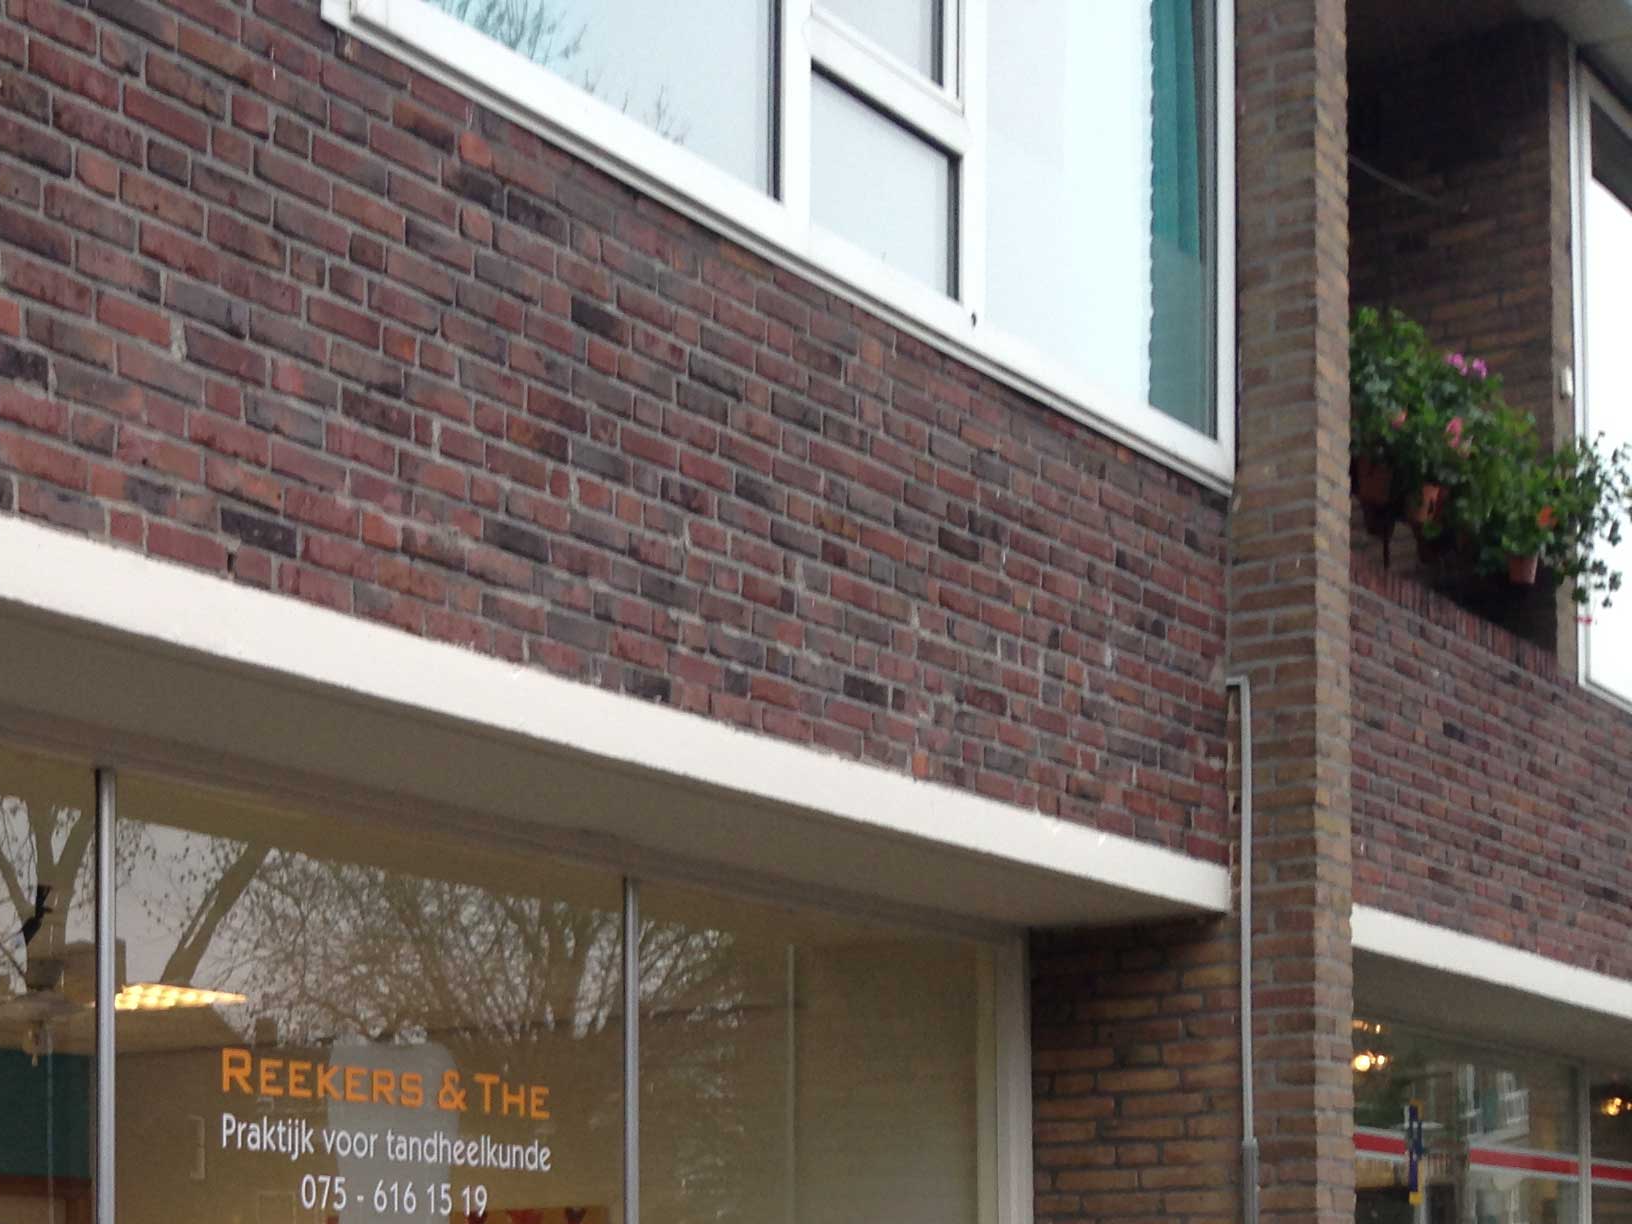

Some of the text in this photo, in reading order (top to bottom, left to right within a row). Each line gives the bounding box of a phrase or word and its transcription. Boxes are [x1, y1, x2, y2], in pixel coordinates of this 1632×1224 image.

[221, 1048, 551, 1121] REEKERS & THE
[221, 1112, 551, 1172] Praktijk voor tandheelkunde
[301, 1174, 347, 1210] 075
[373, 1180, 417, 1214] 616
[426, 1184, 453, 1216] 15
[462, 1185, 488, 1217] 19
